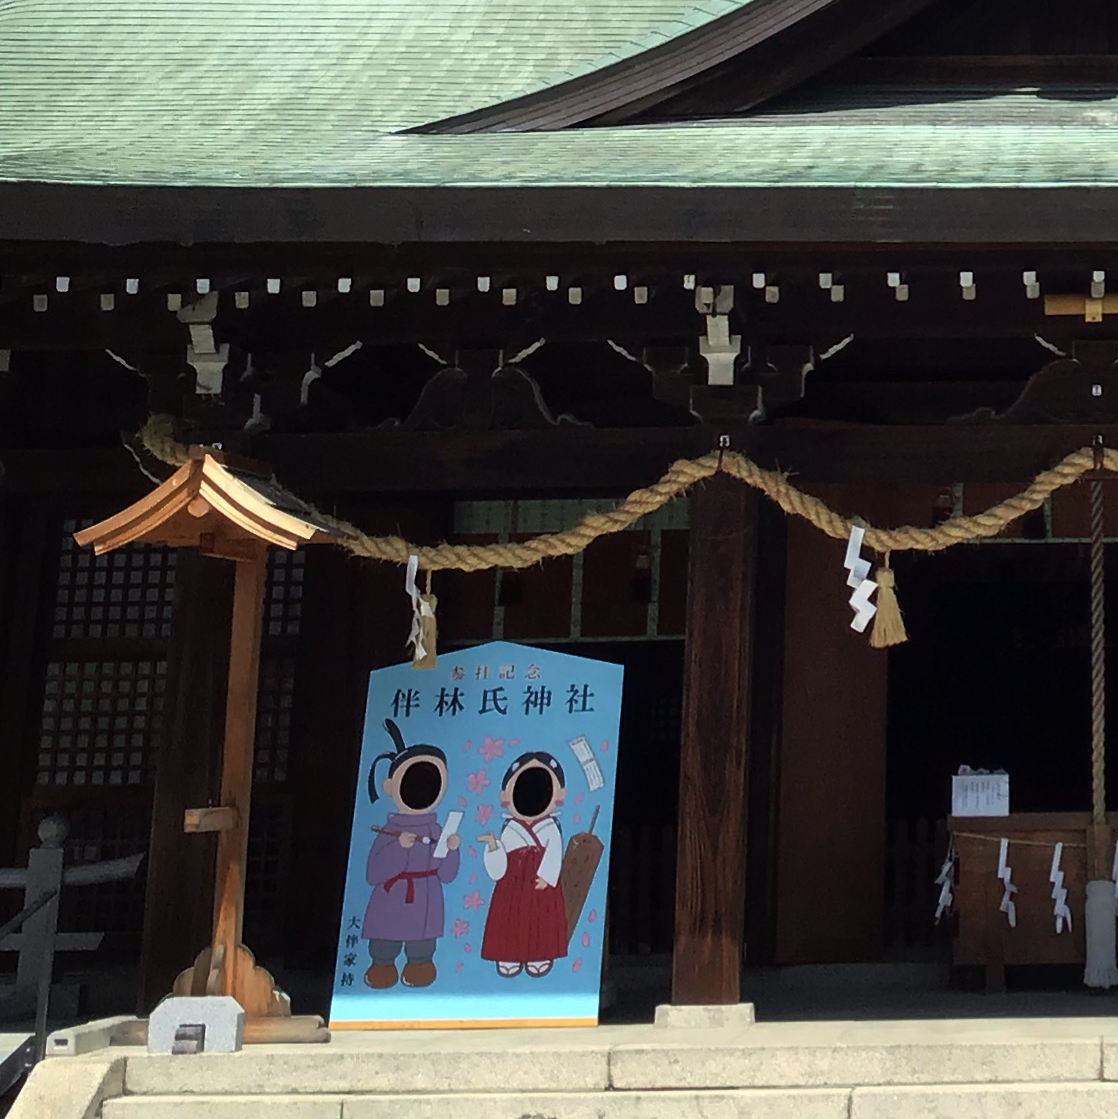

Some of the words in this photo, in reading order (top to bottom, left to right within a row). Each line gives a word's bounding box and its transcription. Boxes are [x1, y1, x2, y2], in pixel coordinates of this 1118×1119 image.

[451, 663, 541, 681] 参拝記念
[391, 684, 595, 718] 伴林氏神社
[340, 915, 361, 987] 大伴家持
